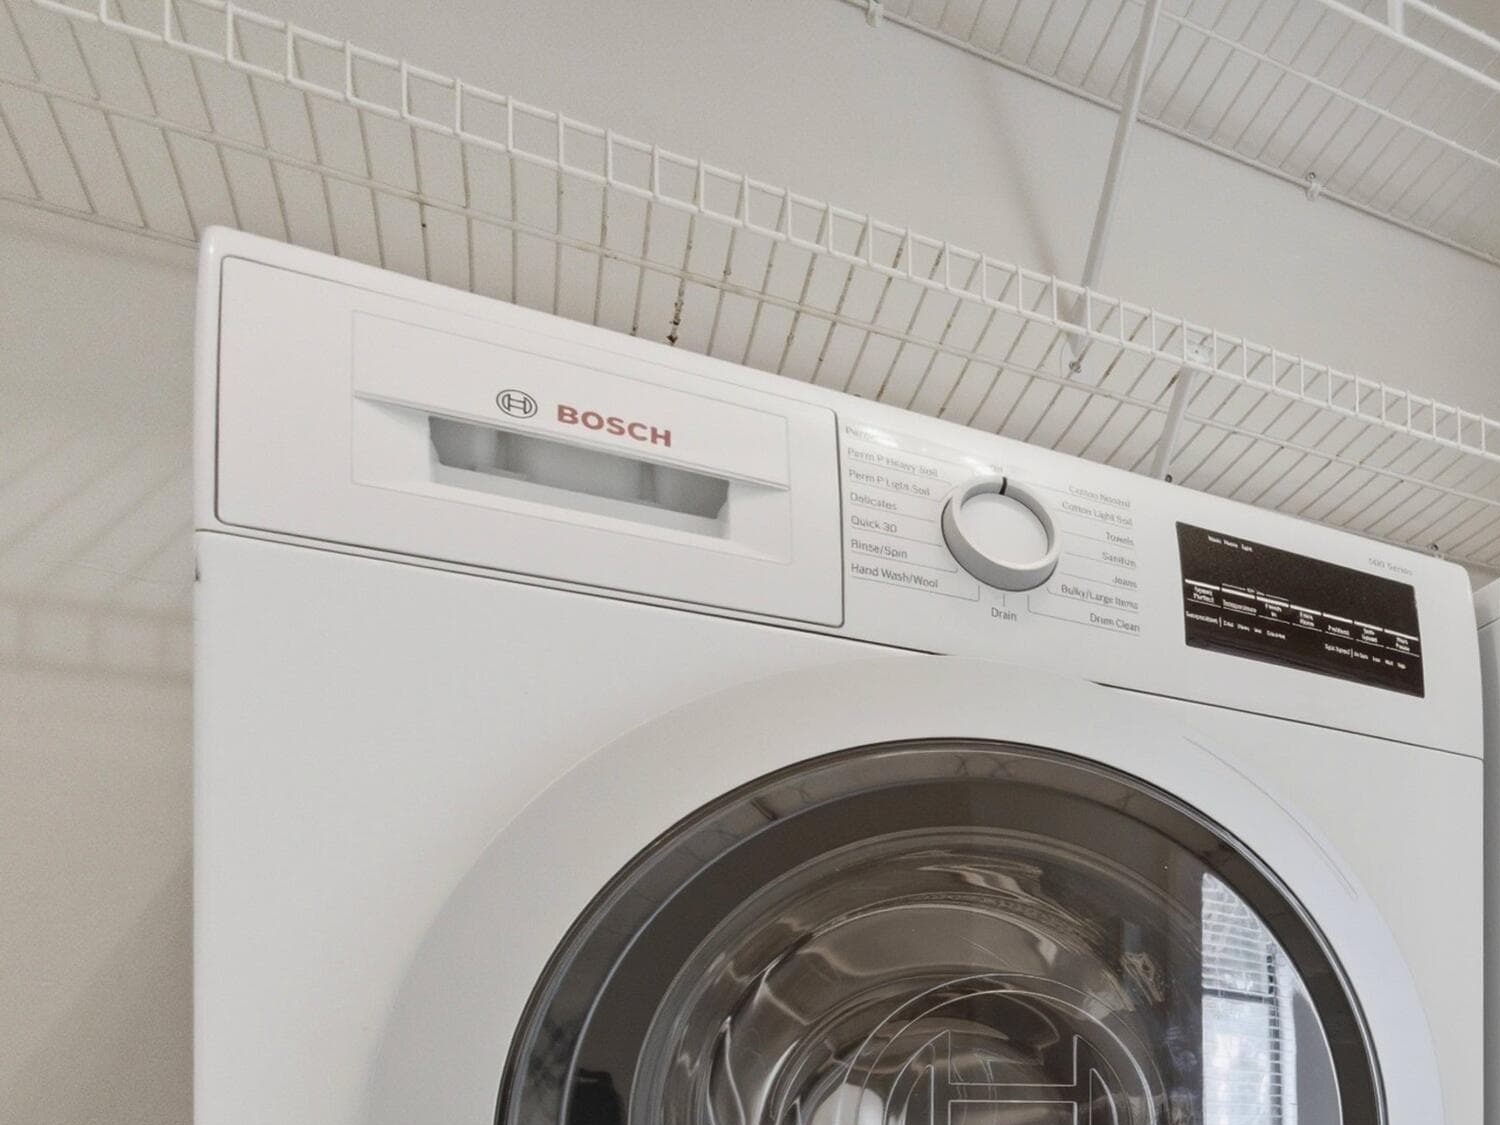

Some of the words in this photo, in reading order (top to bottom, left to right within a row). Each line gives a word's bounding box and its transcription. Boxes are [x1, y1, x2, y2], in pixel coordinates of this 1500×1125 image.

[557, 403, 673, 448] BOSCH
[849, 469, 875, 482] Perm
[912, 484, 931, 496] Soil
[849, 491, 898, 511] Delicates
[850, 514, 882, 529] Quick
[883, 522, 897, 534] 30
[850, 538, 908, 560] Rinse/Spin
[850, 562, 880, 577] Hand
[880, 567, 939, 589] Wash/Wool
[991, 607, 1018, 622] Drain
[1089, 612, 1114, 626] Drum
[1115, 618, 1141, 632] Clean
